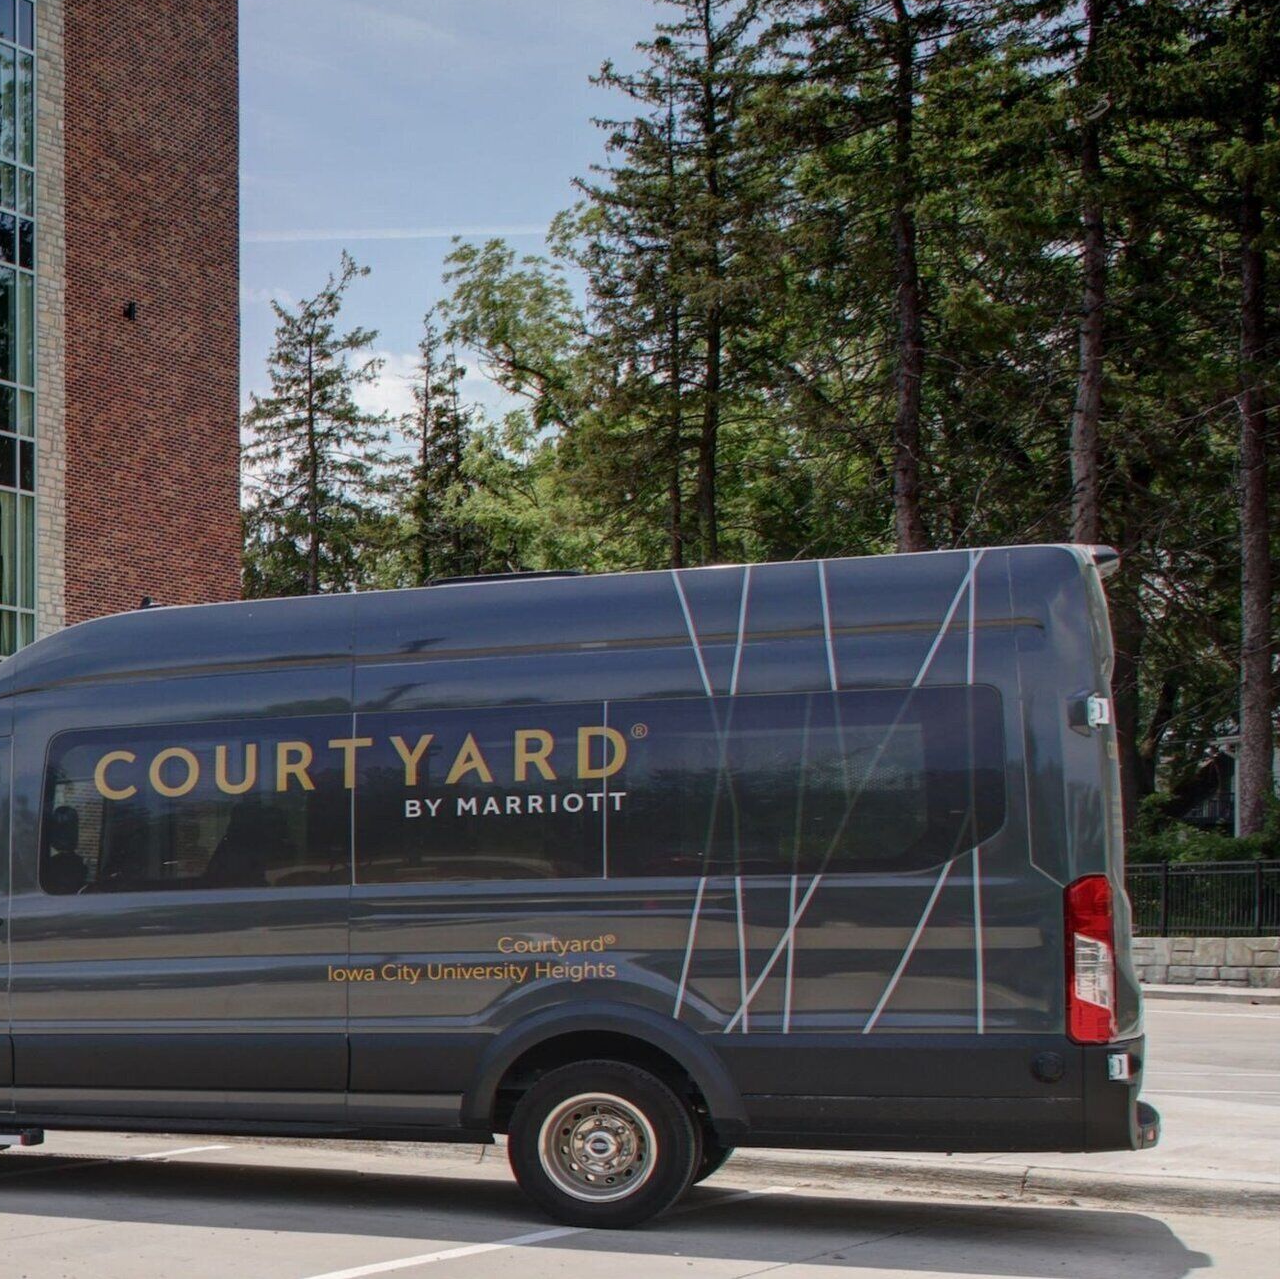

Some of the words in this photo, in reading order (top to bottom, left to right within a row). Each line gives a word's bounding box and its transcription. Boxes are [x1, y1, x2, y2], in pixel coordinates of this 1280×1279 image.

[404, 798, 442, 819] BY
[456, 791, 628, 817] MARRIOTT
[327, 964, 375, 982] Iowa
[381, 963, 421, 985] City
[427, 962, 528, 983] University
[535, 961, 617, 982] Heights
